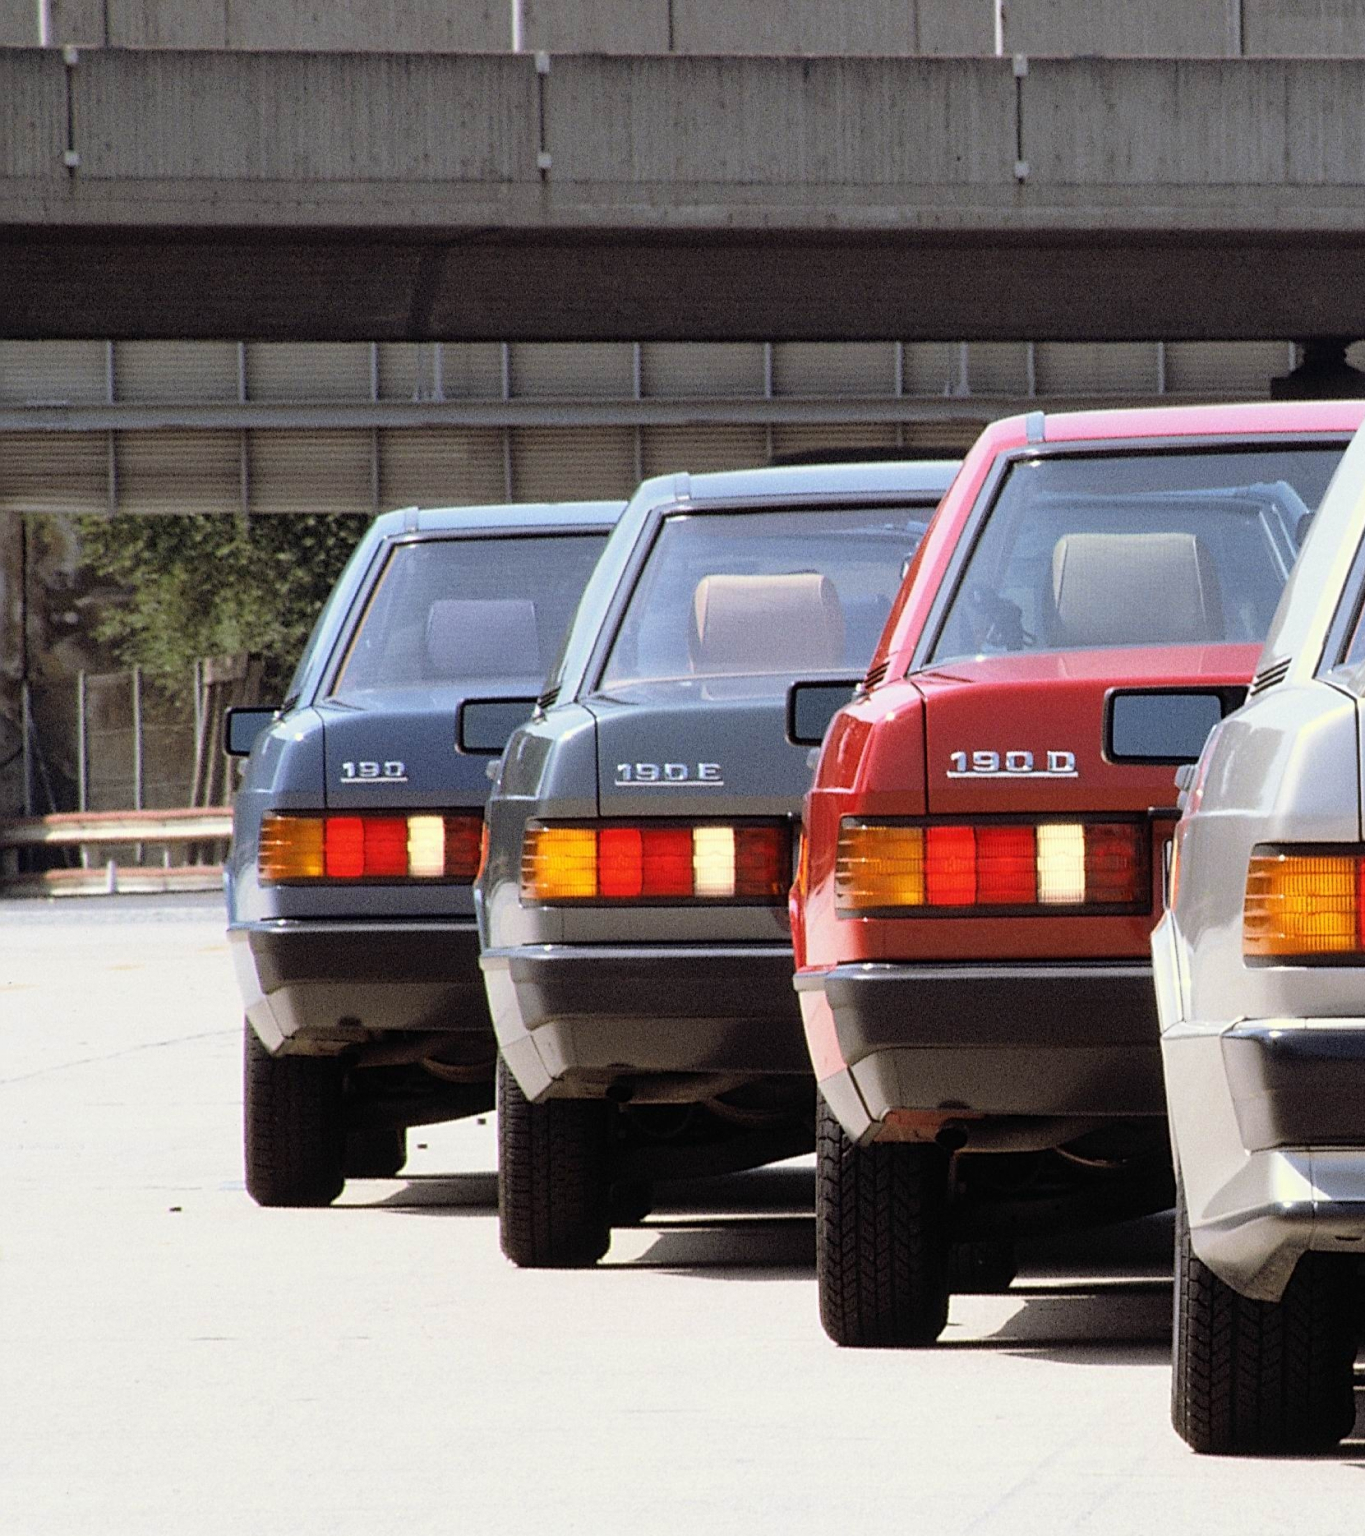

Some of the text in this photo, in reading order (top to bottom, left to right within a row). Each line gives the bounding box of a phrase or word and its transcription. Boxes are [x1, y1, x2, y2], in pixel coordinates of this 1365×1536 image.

[342, 761, 405, 777] 190
[950, 750, 1075, 772] 190 D
[617, 763, 721, 781] 190 E
